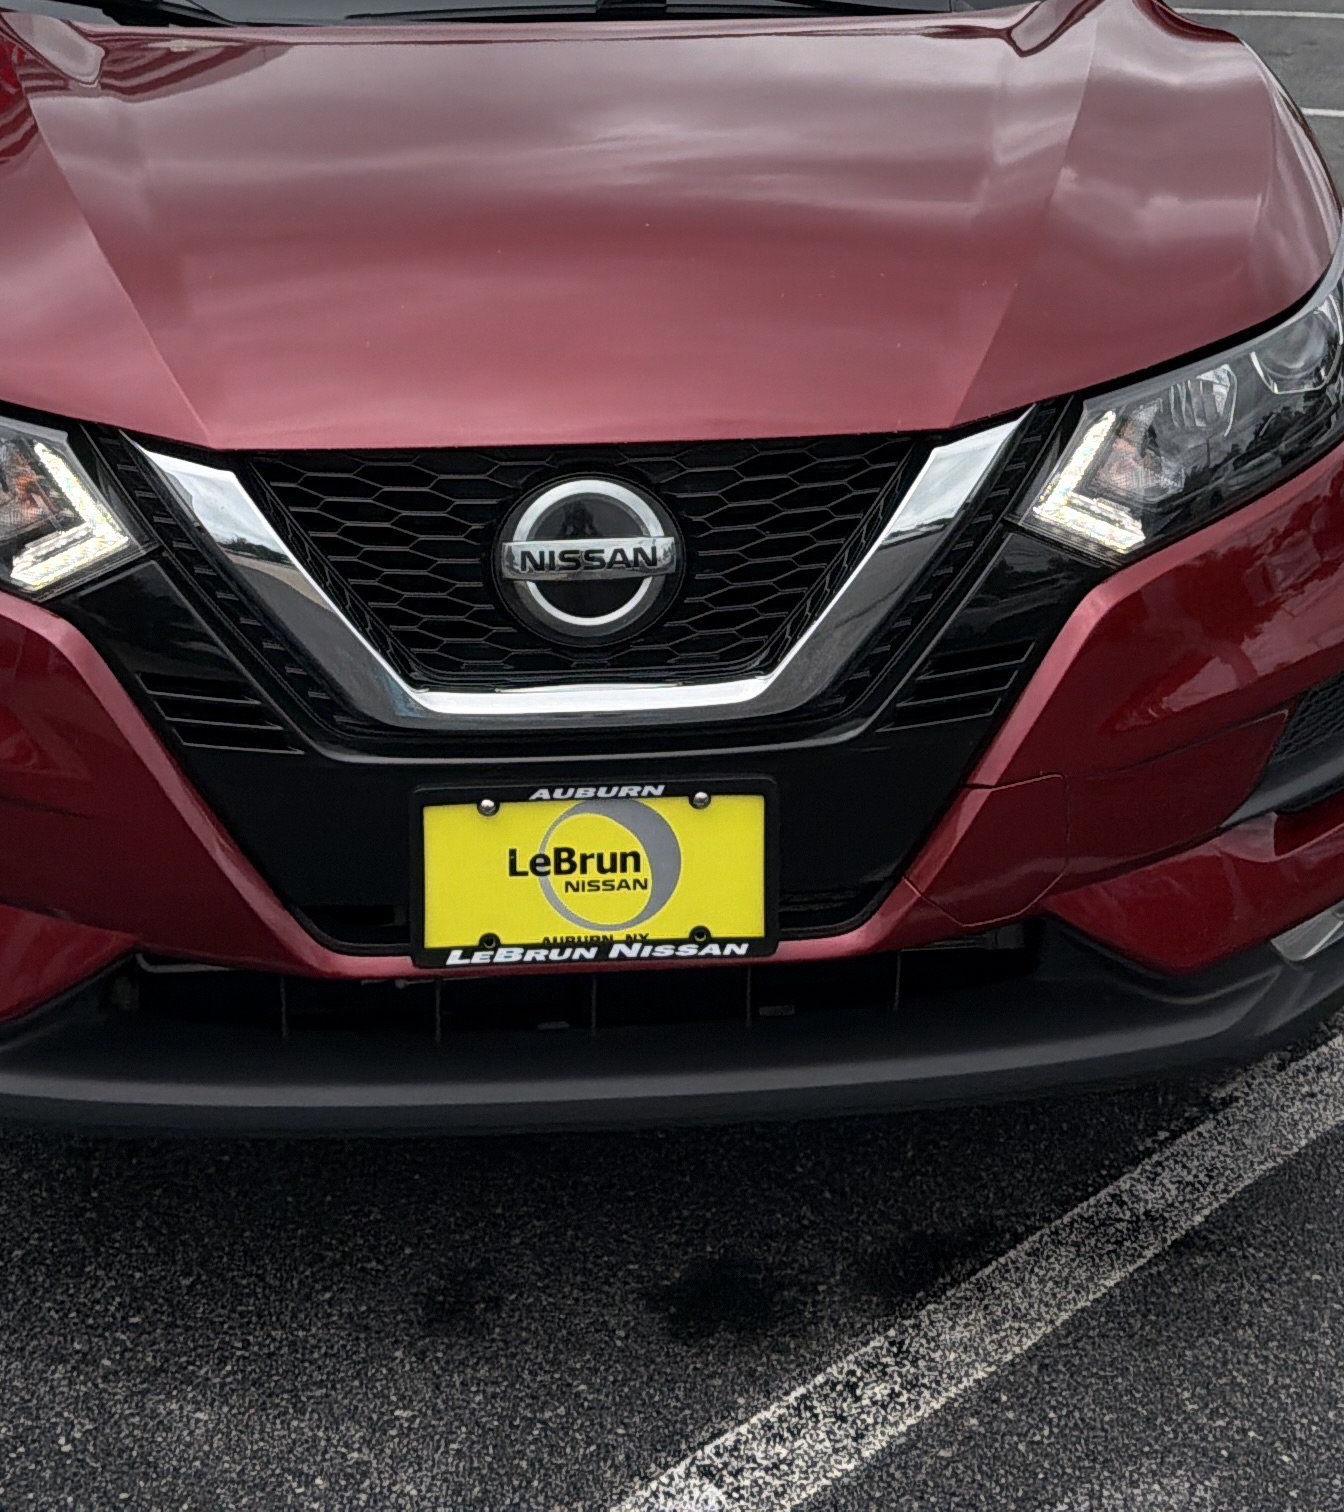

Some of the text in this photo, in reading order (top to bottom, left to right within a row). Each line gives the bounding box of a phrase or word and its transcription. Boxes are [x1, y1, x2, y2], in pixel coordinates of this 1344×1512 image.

[520, 545, 658, 572] NISSAN
[529, 784, 666, 800] AUBURN
[508, 847, 641, 877] LeBrun
[564, 877, 649, 894] NISSAN
[608, 941, 749, 960] NISSAN
